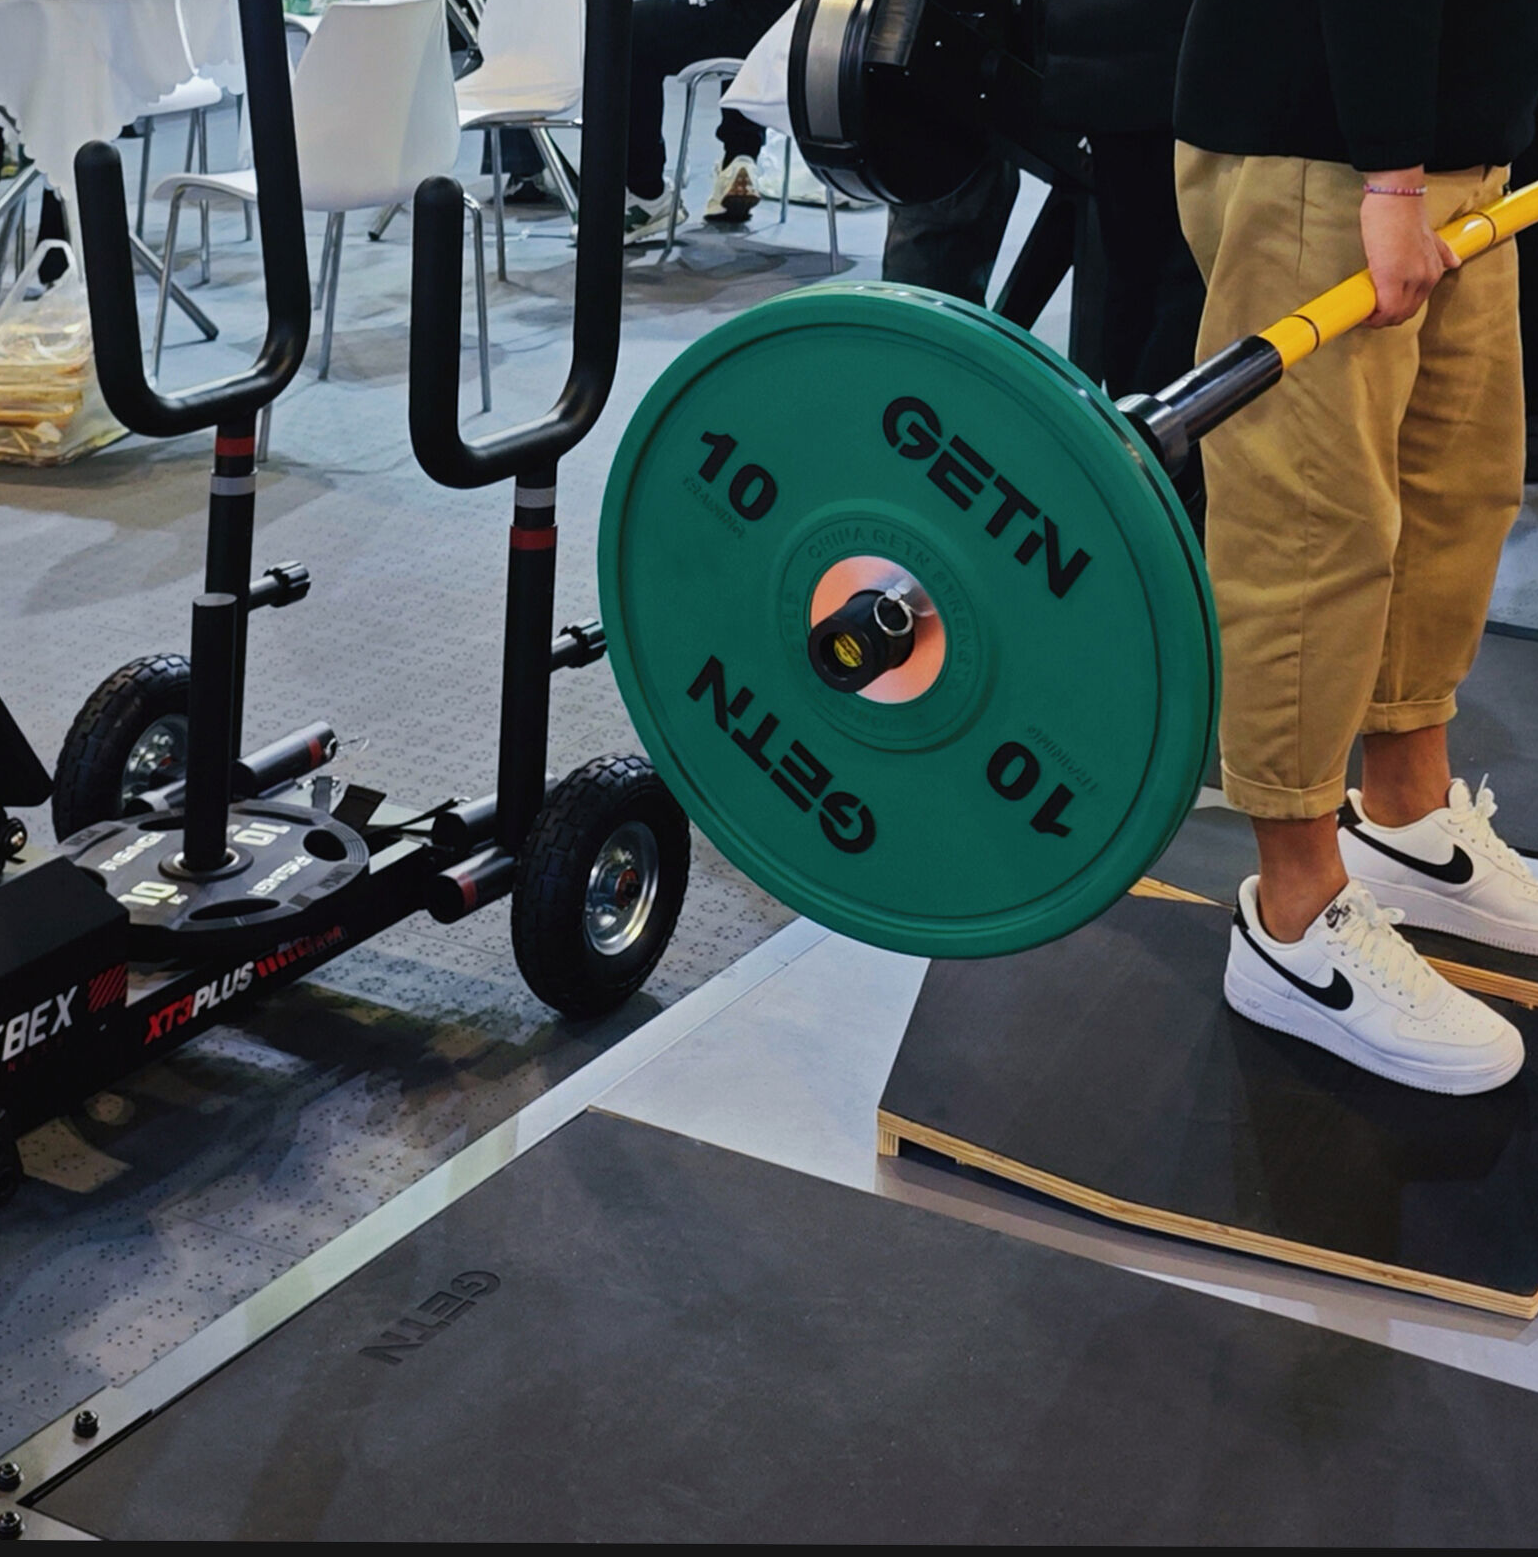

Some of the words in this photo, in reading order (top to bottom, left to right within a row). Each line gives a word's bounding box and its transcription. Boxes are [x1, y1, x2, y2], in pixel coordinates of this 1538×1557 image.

[699, 429, 779, 523] 10
[881, 395, 1094, 601] GETN
[685, 655, 878, 855] GETN
[986, 740, 1081, 839] 10
[233, 822, 292, 847] 10
[117, 880, 179, 907] 10
[358, 1269, 502, 1368] GETN
